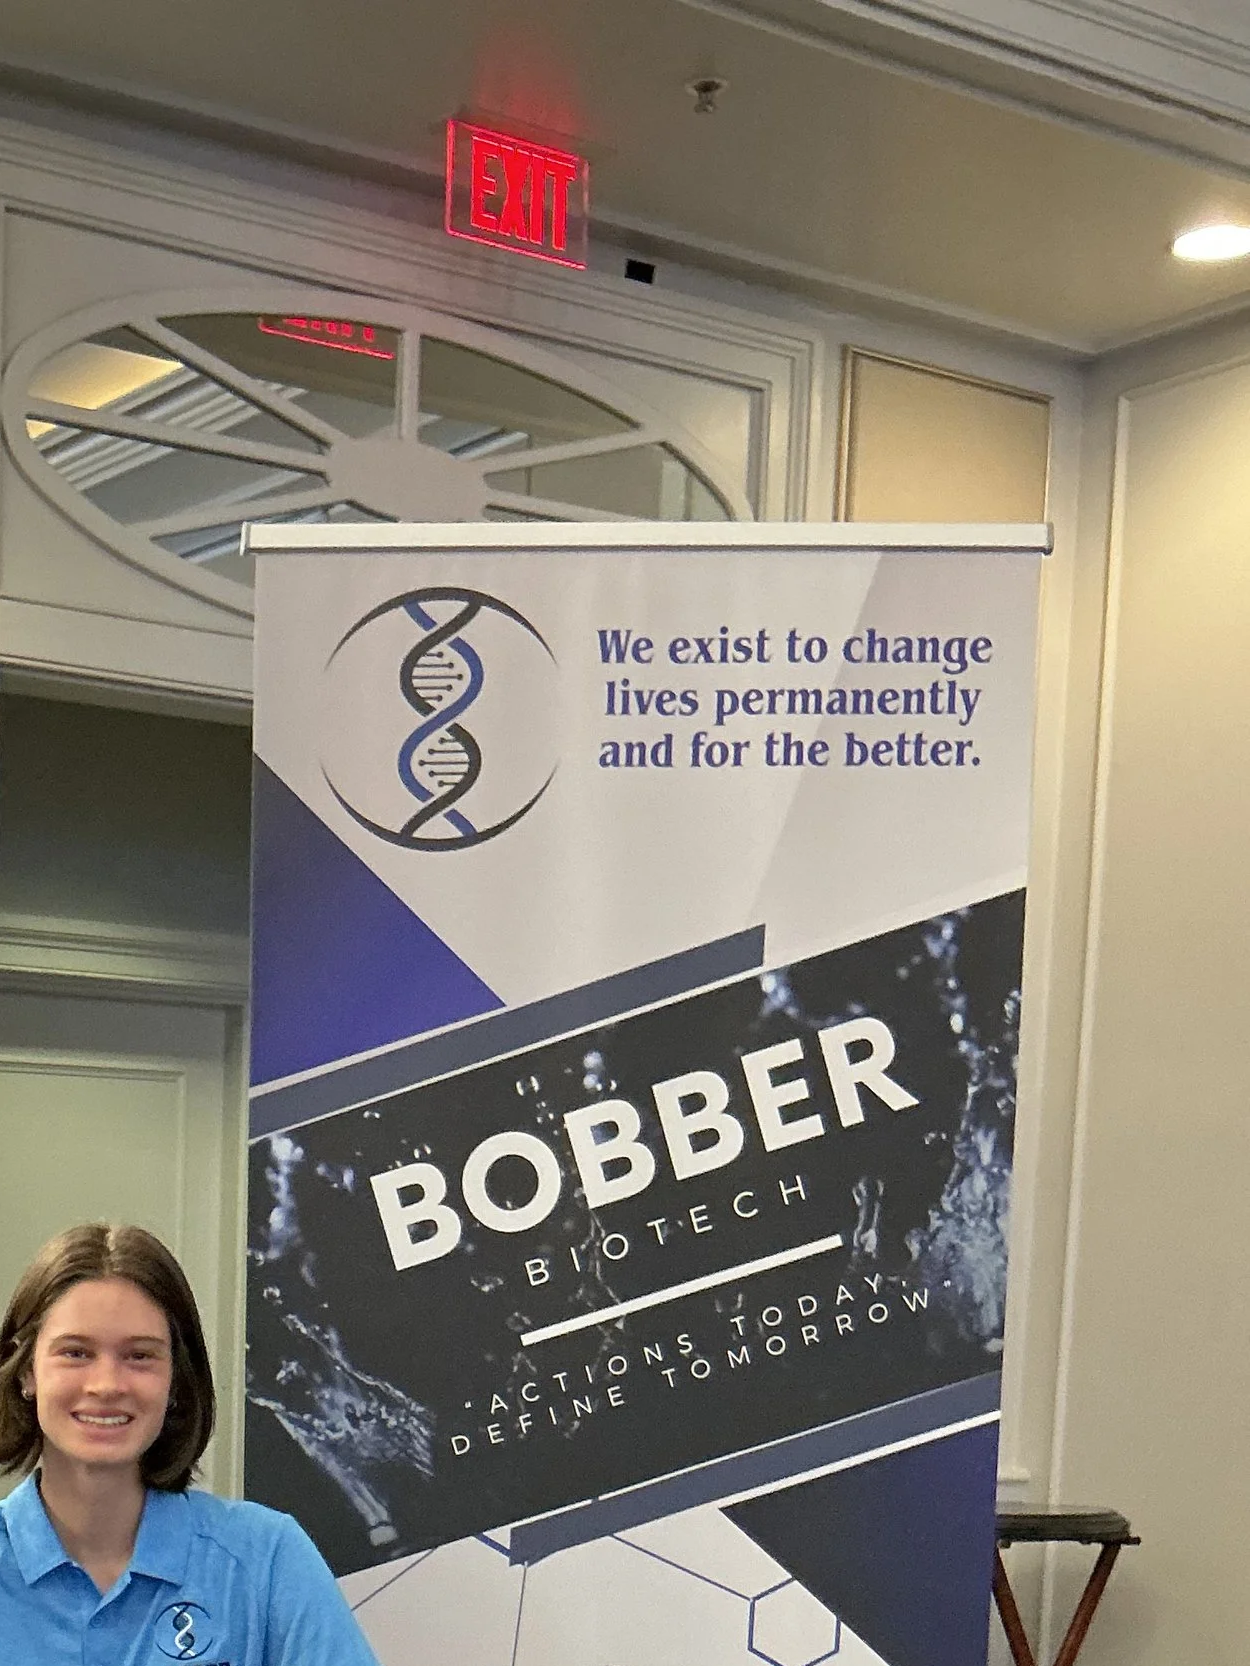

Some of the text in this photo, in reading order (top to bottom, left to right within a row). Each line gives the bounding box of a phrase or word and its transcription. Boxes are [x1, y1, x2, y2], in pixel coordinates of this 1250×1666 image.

[470, 135, 577, 252] EXIT
[597, 626, 992, 675] We exist to change
[604, 678, 983, 726] lives permanently
[598, 731, 981, 768] and for the better.
[369, 1017, 920, 1272] BOBBER
[524, 1174, 806, 1286] BIOTECH
[451, 1385, 625, 1455] DEFINE
